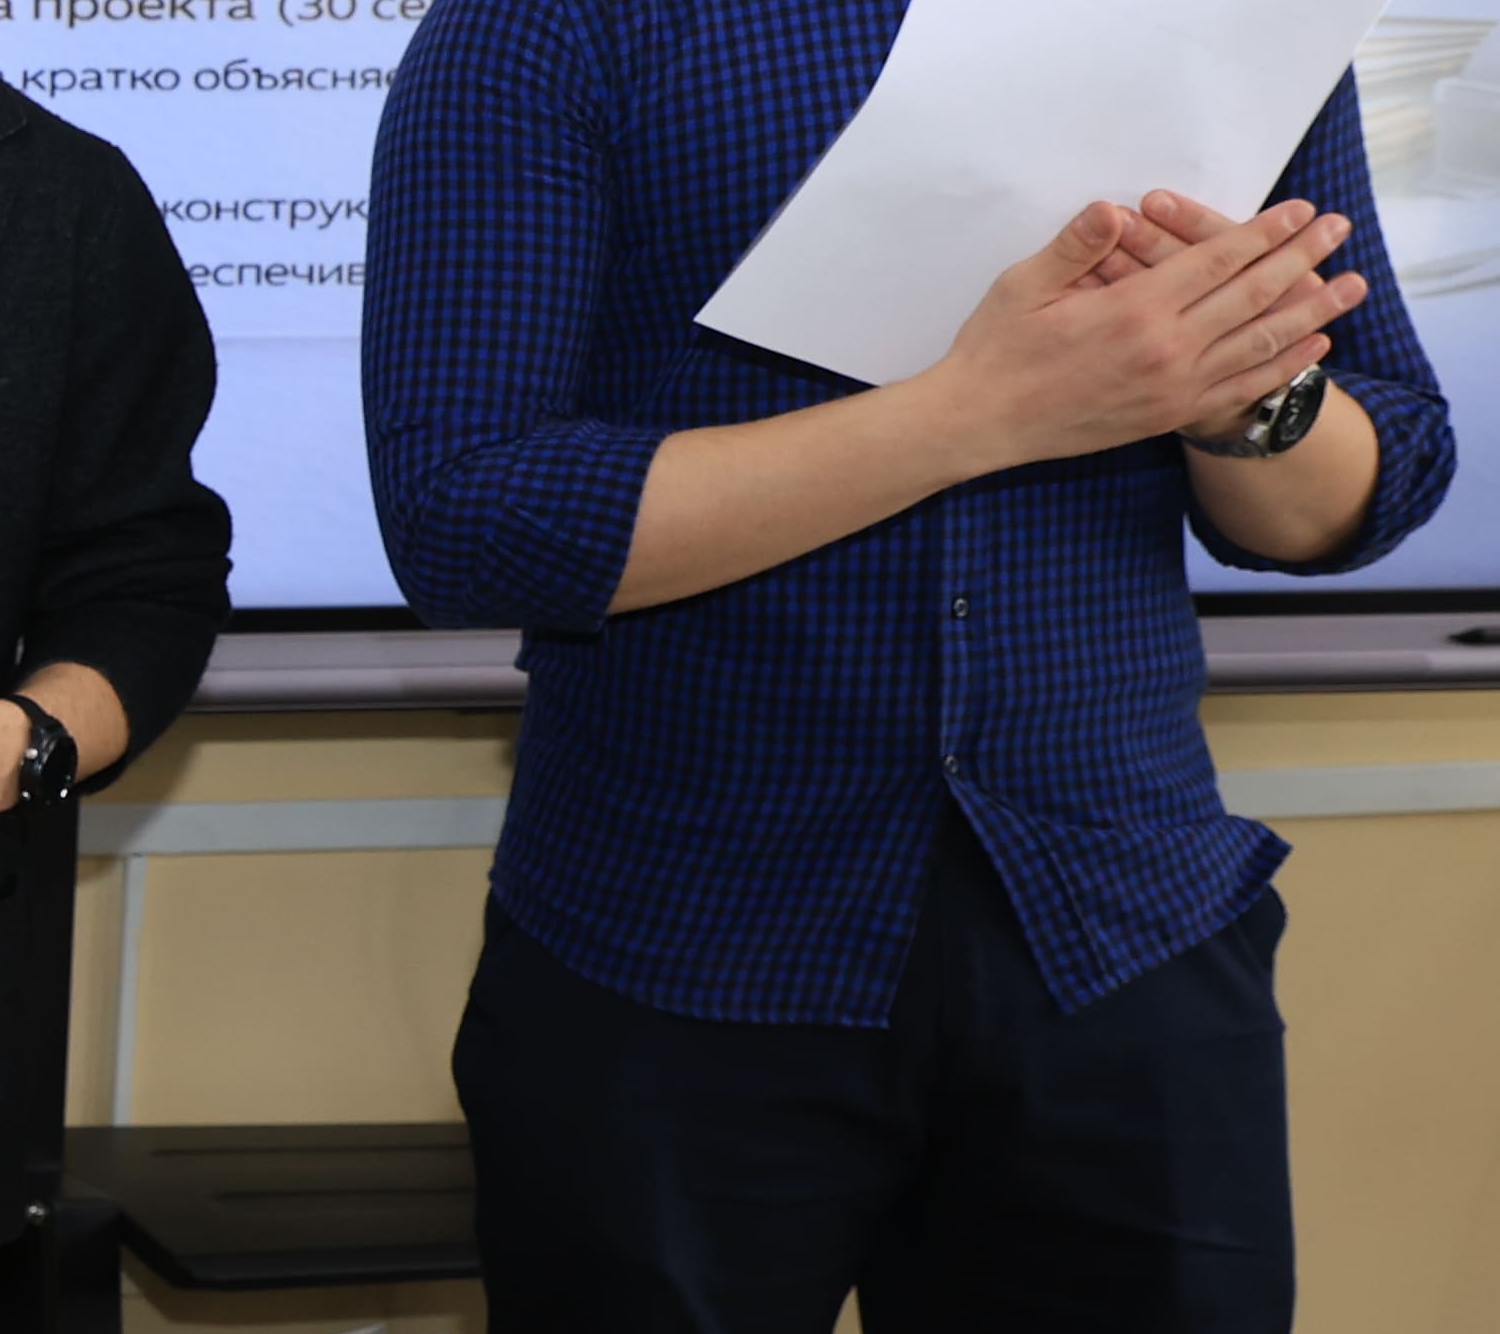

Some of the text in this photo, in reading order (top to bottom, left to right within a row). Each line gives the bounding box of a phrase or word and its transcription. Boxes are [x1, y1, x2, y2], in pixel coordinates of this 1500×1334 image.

[21, 67, 181, 96] кратко
[162, 198, 369, 231] конструк
[188, 262, 367, 288] еспечив
